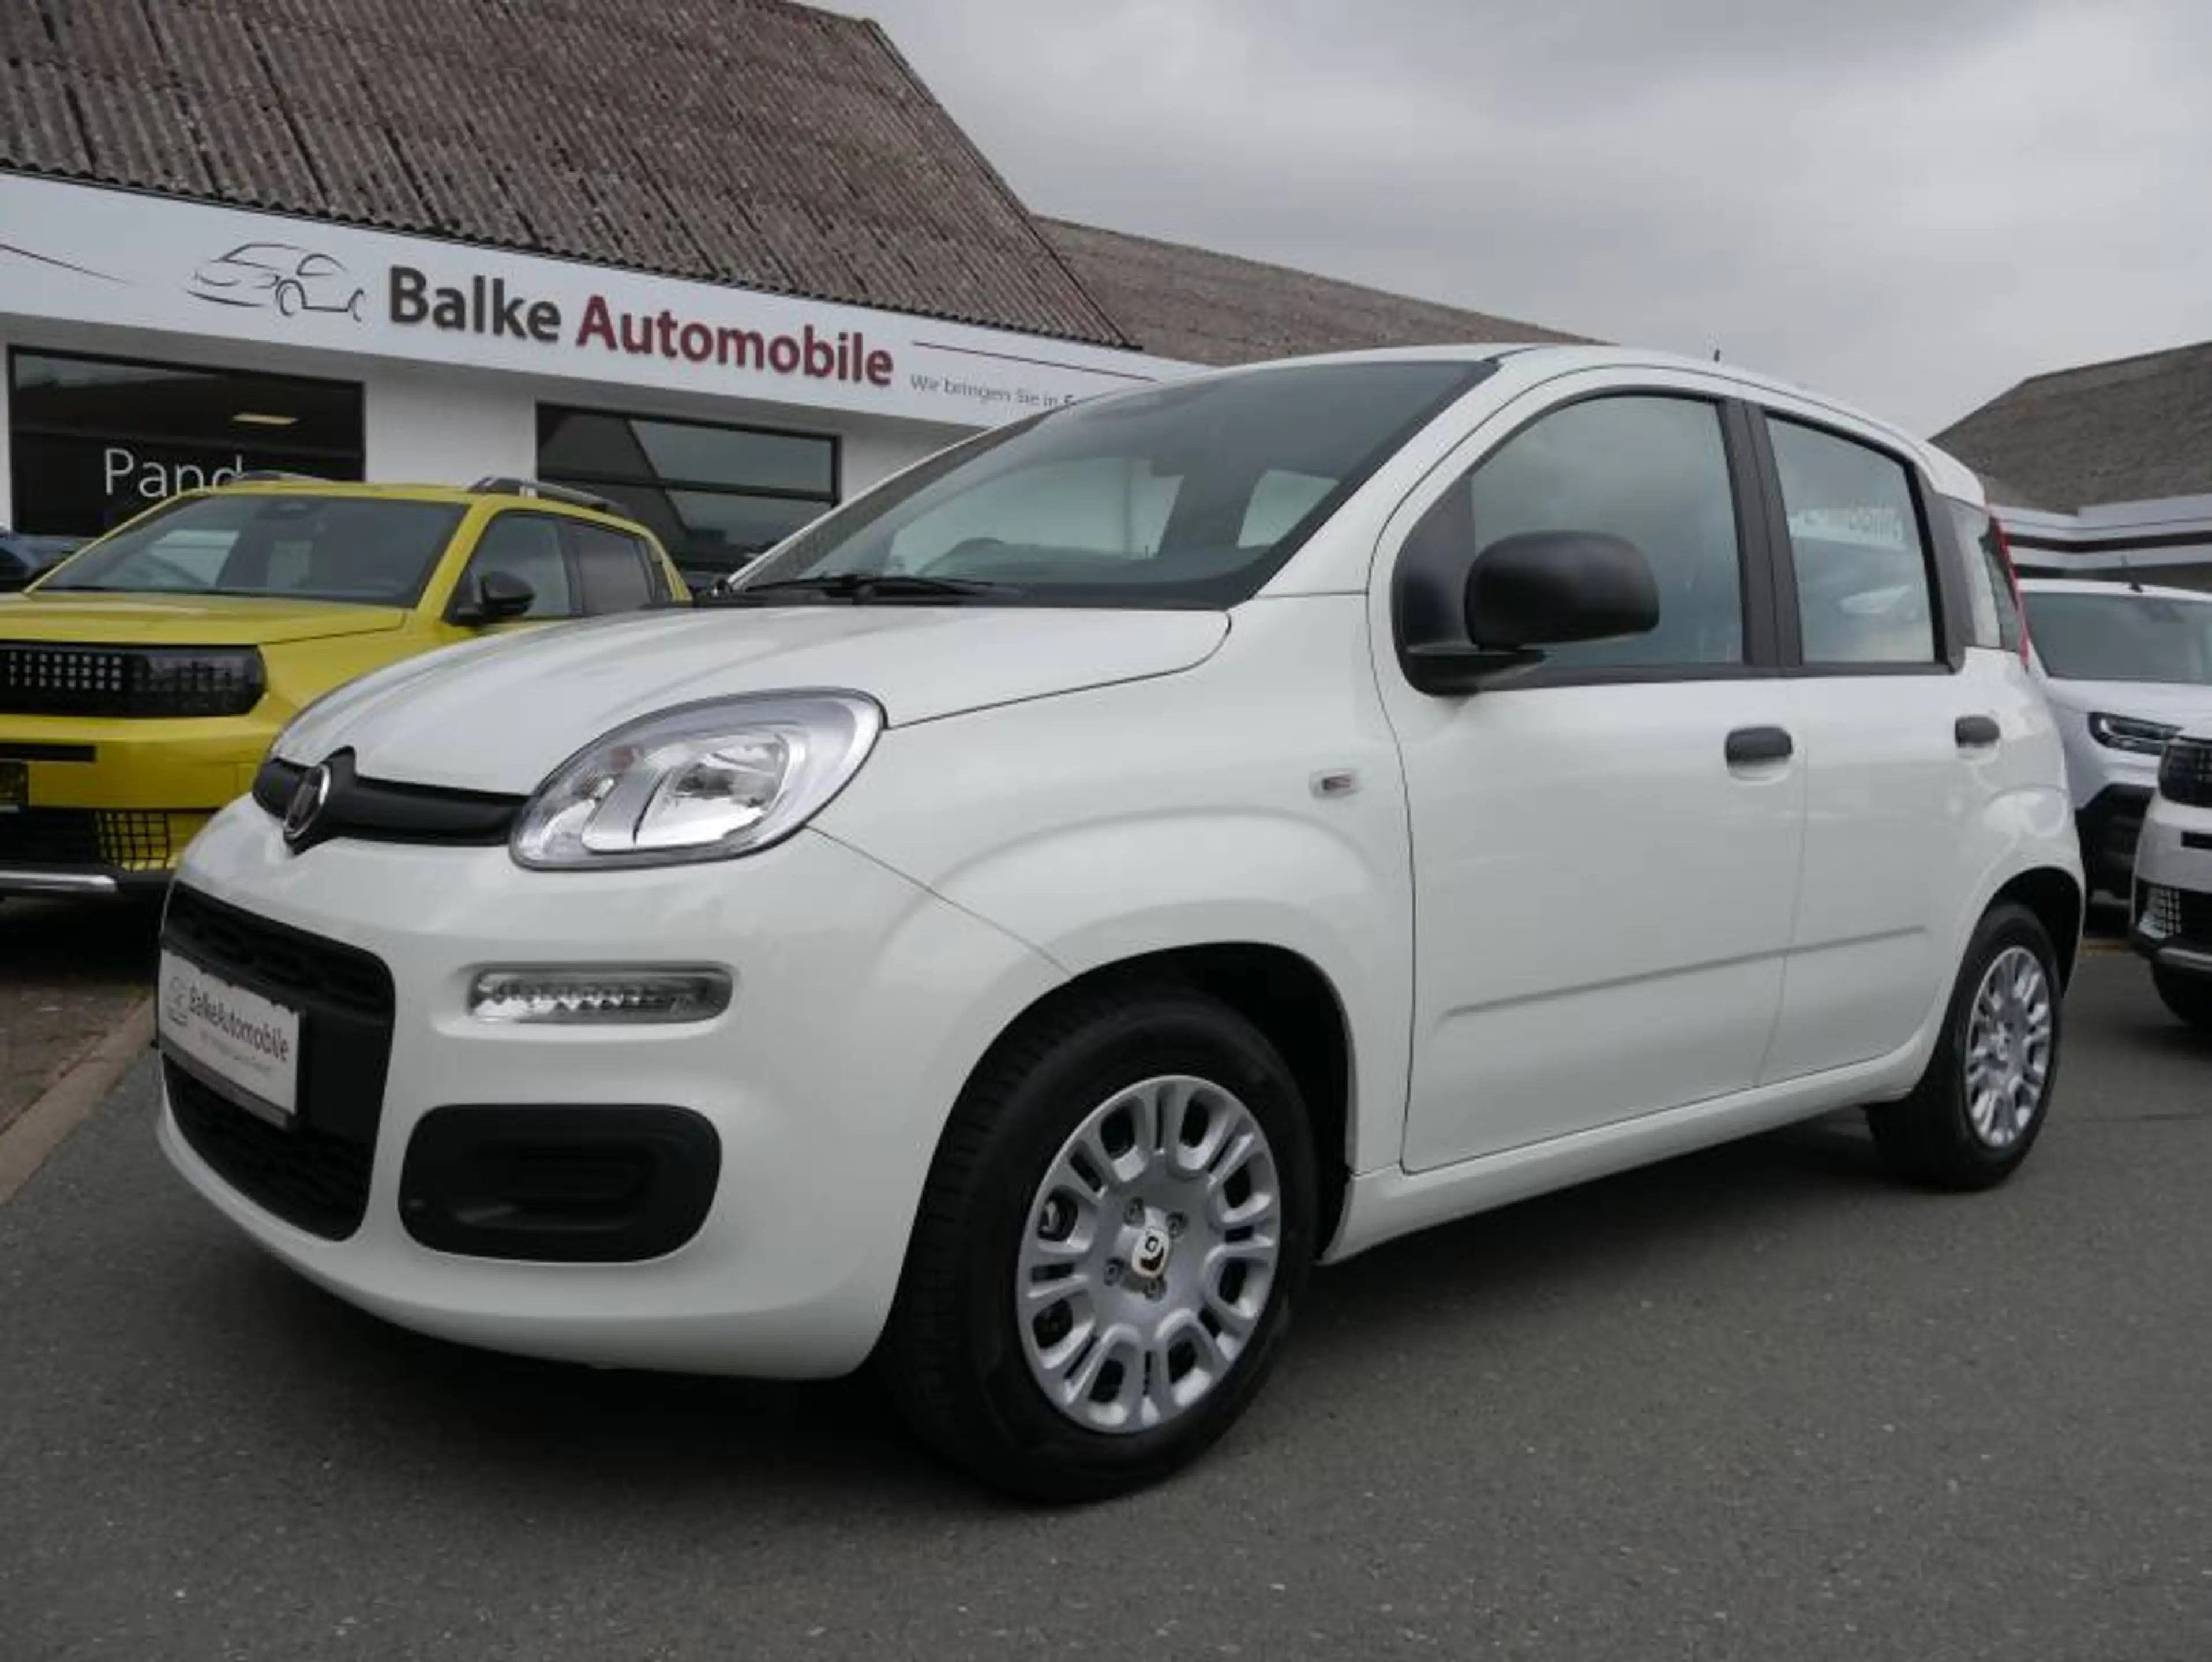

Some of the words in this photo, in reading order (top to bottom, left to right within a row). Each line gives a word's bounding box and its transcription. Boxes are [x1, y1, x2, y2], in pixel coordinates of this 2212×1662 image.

[390, 265, 561, 343] Balke
[576, 294, 894, 386] Automobile
[910, 373, 939, 394] Wir
[944, 377, 1011, 405] bringen
[1015, 388, 1040, 405] Sie
[1043, 394, 1058, 407] in
